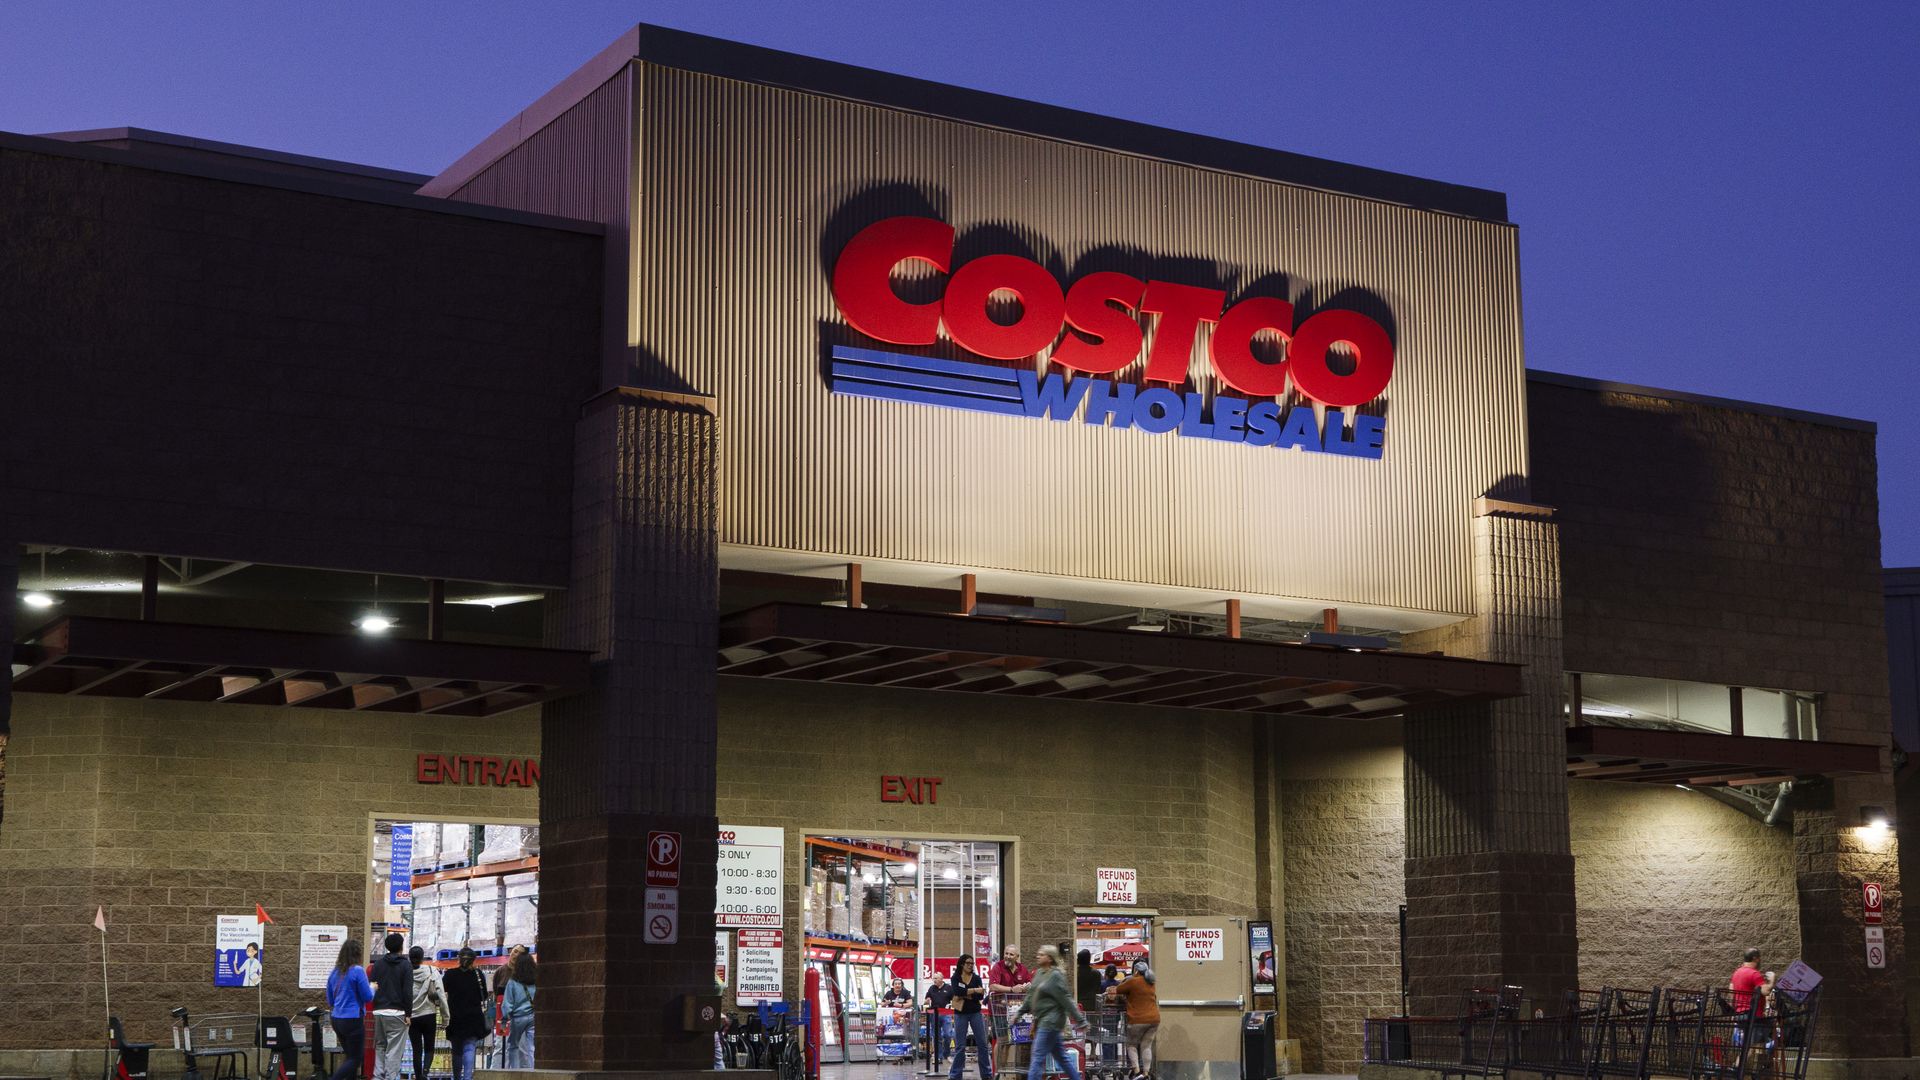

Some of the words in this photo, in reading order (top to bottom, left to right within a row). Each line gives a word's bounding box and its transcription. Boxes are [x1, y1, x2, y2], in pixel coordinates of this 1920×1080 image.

[832, 215, 1395, 407] COSTCO
[1016, 369, 1386, 460] WHOLESALE
[881, 775, 944, 804] EXIT
[728, 850, 751, 859] ONLY
[647, 870, 655, 878] NO
[656, 870, 678, 879] PARKING
[721, 868, 749, 877] 10:00
[756, 869, 777, 878] 8:30
[1099, 870, 1135, 880] REFUNDS
[726, 886, 748, 894] 9:30
[755, 886, 777, 895] 6:00
[1107, 881, 1128, 891] ONLY
[657, 893, 666, 901] NO
[1102, 892, 1132, 901] PLEASE
[647, 902, 676, 910] SMOKING
[720, 904, 748, 913] 10:00
[755, 905, 777, 914] 6:00
[716, 914, 724, 924] AT
[724, 914, 780, 925] WWW.COSTCO.COM
[1179, 930, 1220, 939] REFUNDS
[1185, 940, 1214, 949] ENTRY
[1188, 950, 1211, 959] ONLY
[740, 983, 780, 991] PROHIBITED
